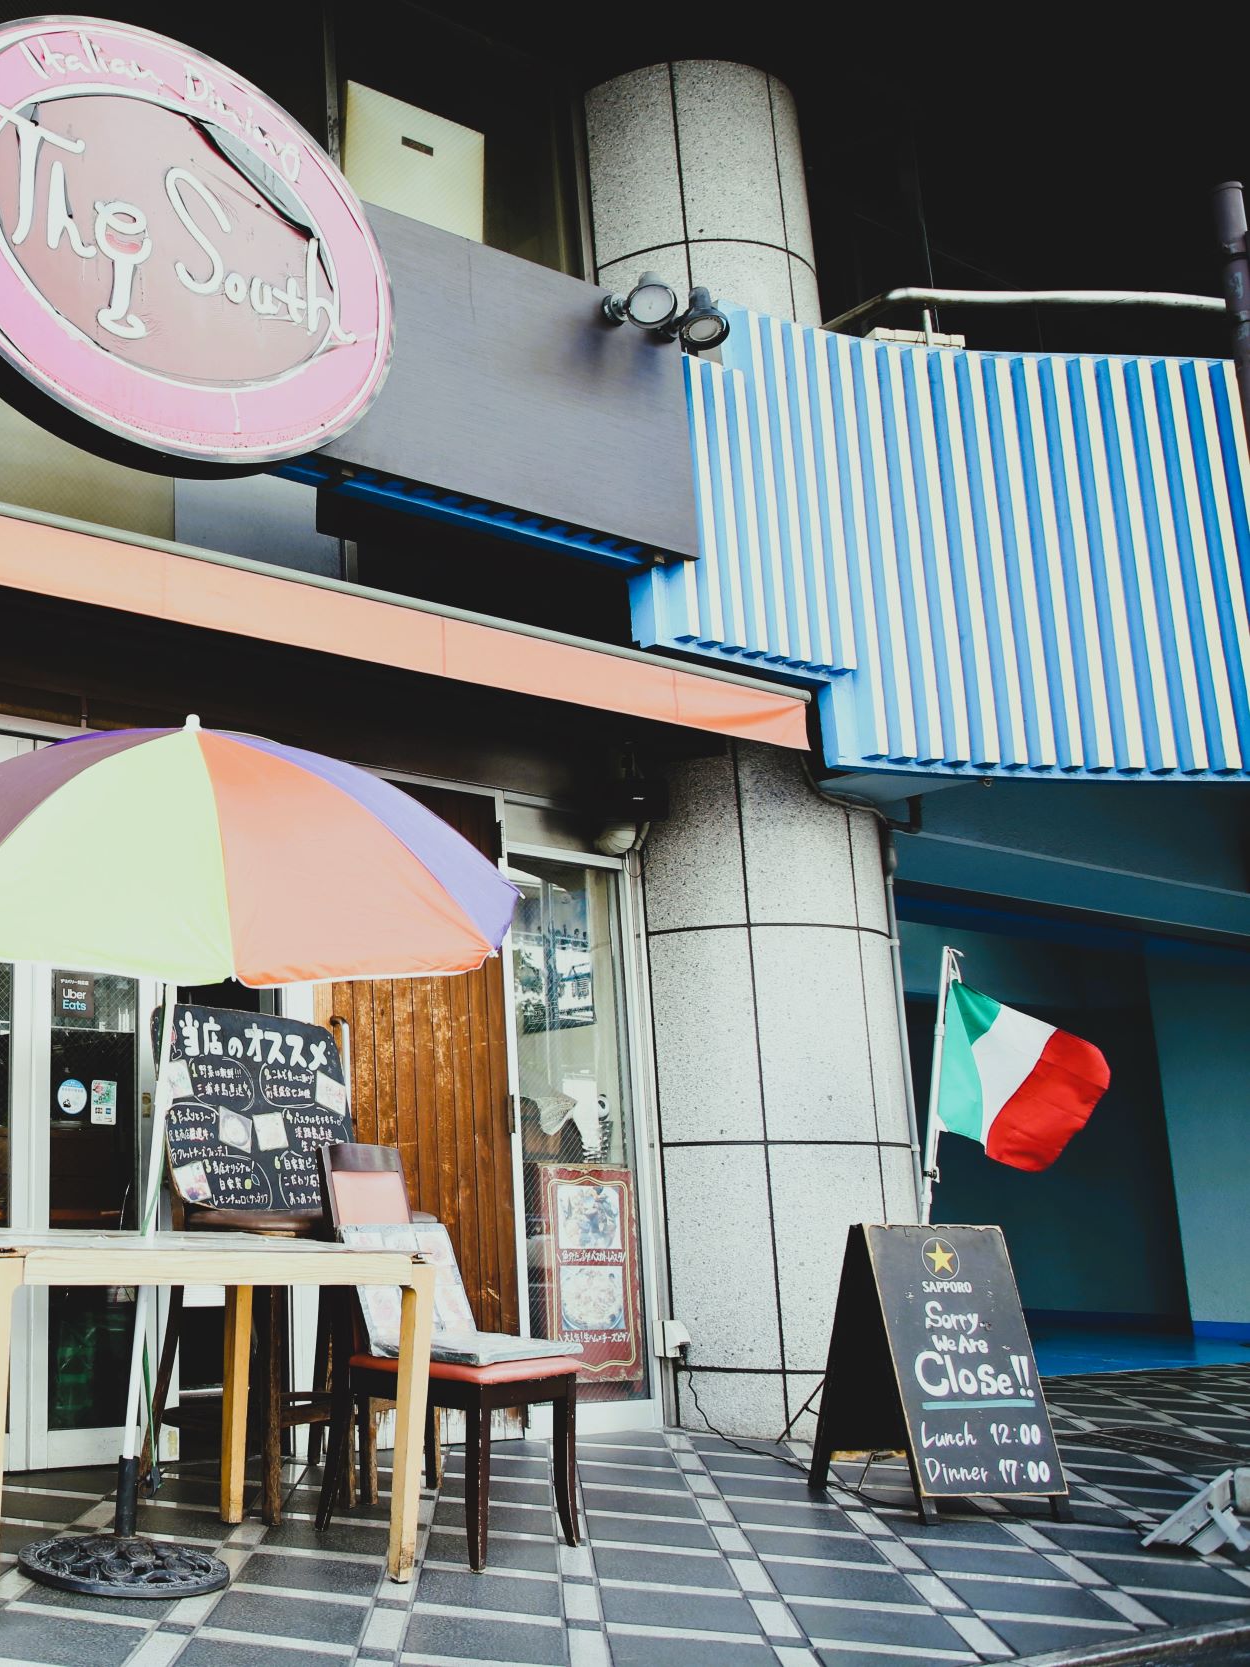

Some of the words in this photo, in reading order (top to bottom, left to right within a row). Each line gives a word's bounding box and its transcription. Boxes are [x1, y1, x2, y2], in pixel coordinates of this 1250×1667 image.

[19, 31, 164, 85] Italian
[183, 62, 301, 183] Dining
[165, 166, 357, 344] South
[62, 988, 87, 1000] Uber
[62, 999, 87, 1011] Eats
[179, 1011, 328, 1070] 当店のオススメ
[921, 1281, 972, 1293] SAPPORO
[931, 1334, 957, 1352] We
[958, 1333, 989, 1354] Are
[914, 1350, 1035, 1398] Close!!
[920, 1422, 977, 1449] Lunch
[990, 1423, 1042, 1446] 12:00
[924, 1457, 989, 1484] Dinner
[998, 1458, 1050, 1484] 17:00
